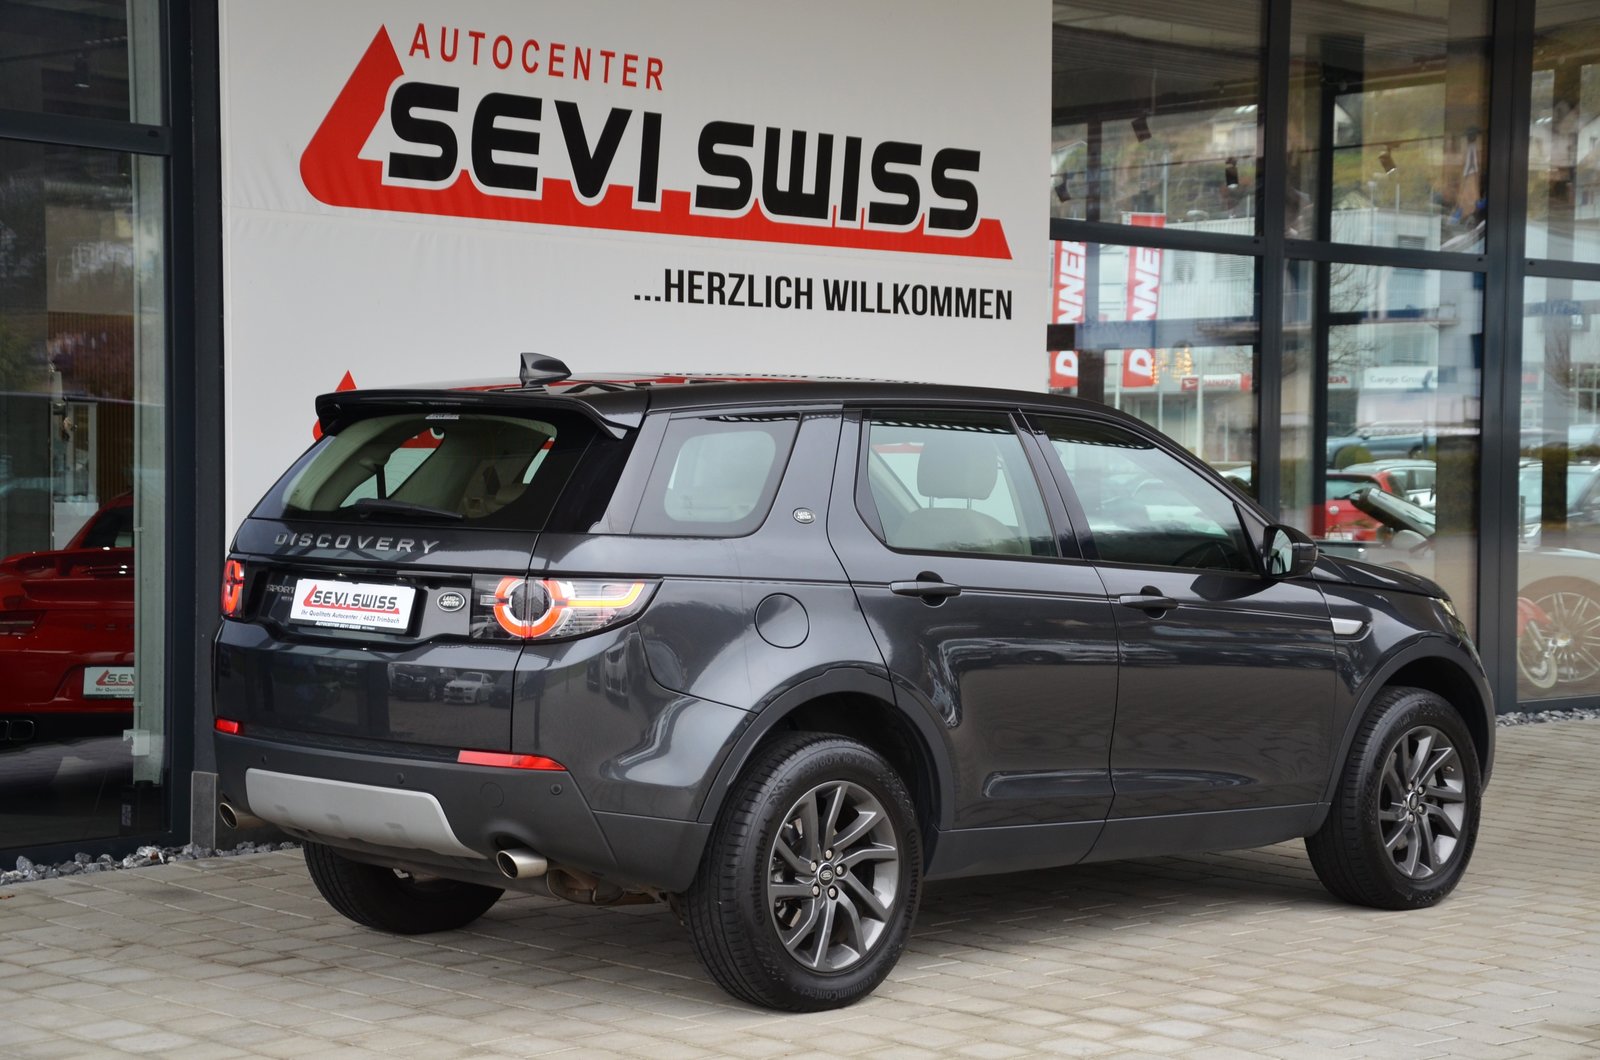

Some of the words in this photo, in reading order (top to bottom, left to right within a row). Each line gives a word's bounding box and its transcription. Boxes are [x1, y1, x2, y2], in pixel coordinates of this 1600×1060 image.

[409, 23, 664, 91] AUTOCENTER
[388, 81, 662, 204] SEVI
[695, 120, 981, 231] SWISS
[634, 268, 813, 310] ...HERZLICH
[822, 278, 1013, 320] WILLKOMMEN
[1056, 240, 1086, 377] DNNE
[1129, 246, 1161, 376] DNNE
[275, 532, 440, 554] DISCOVERY
[266, 584, 296, 594] SPORT
[313, 590, 349, 606] SEVI
[351, 593, 398, 610] SWISS
[107, 674, 134, 683] SE
